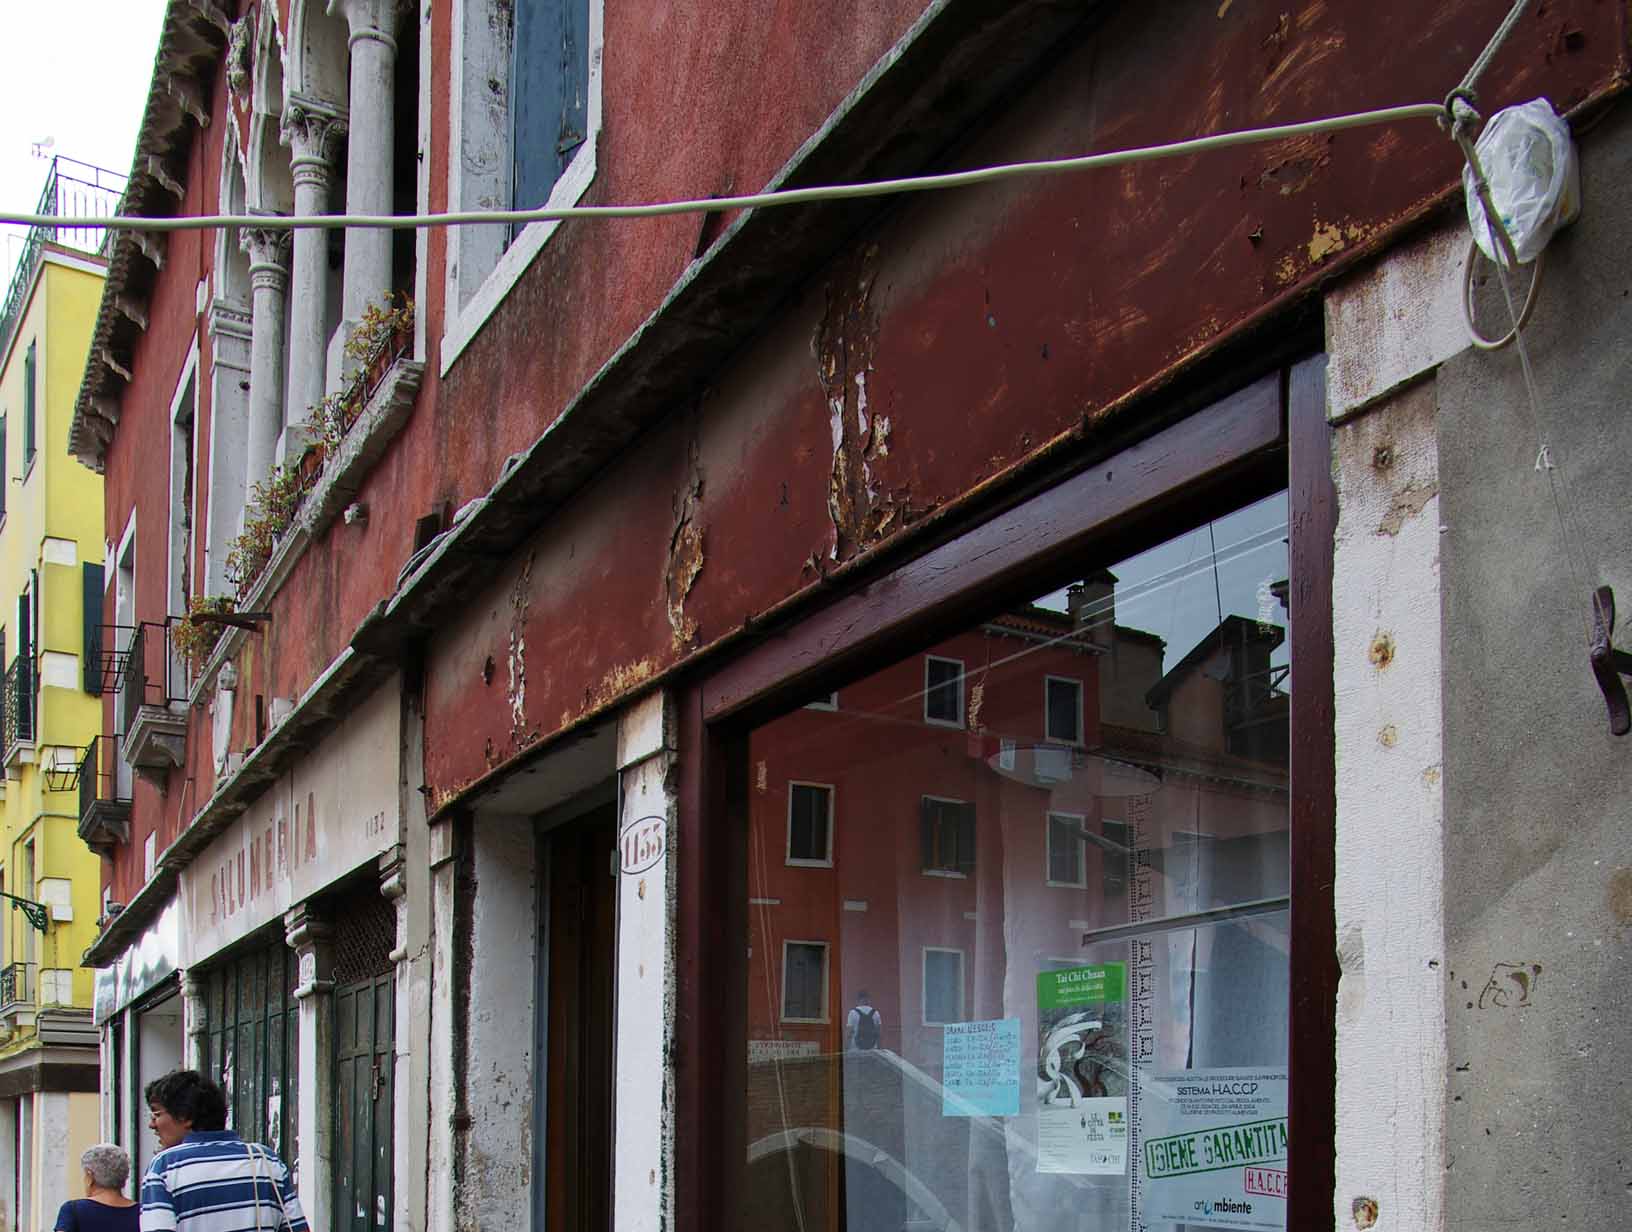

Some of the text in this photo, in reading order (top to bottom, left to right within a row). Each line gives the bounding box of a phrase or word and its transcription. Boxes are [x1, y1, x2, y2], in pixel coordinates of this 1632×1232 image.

[211, 791, 318, 928] SALUMERIA
[625, 823, 663, 869] 1163
[1177, 1086, 1211, 1096] SISTEMA
[1148, 1122, 1288, 1173] IGIENE GARANTITA
